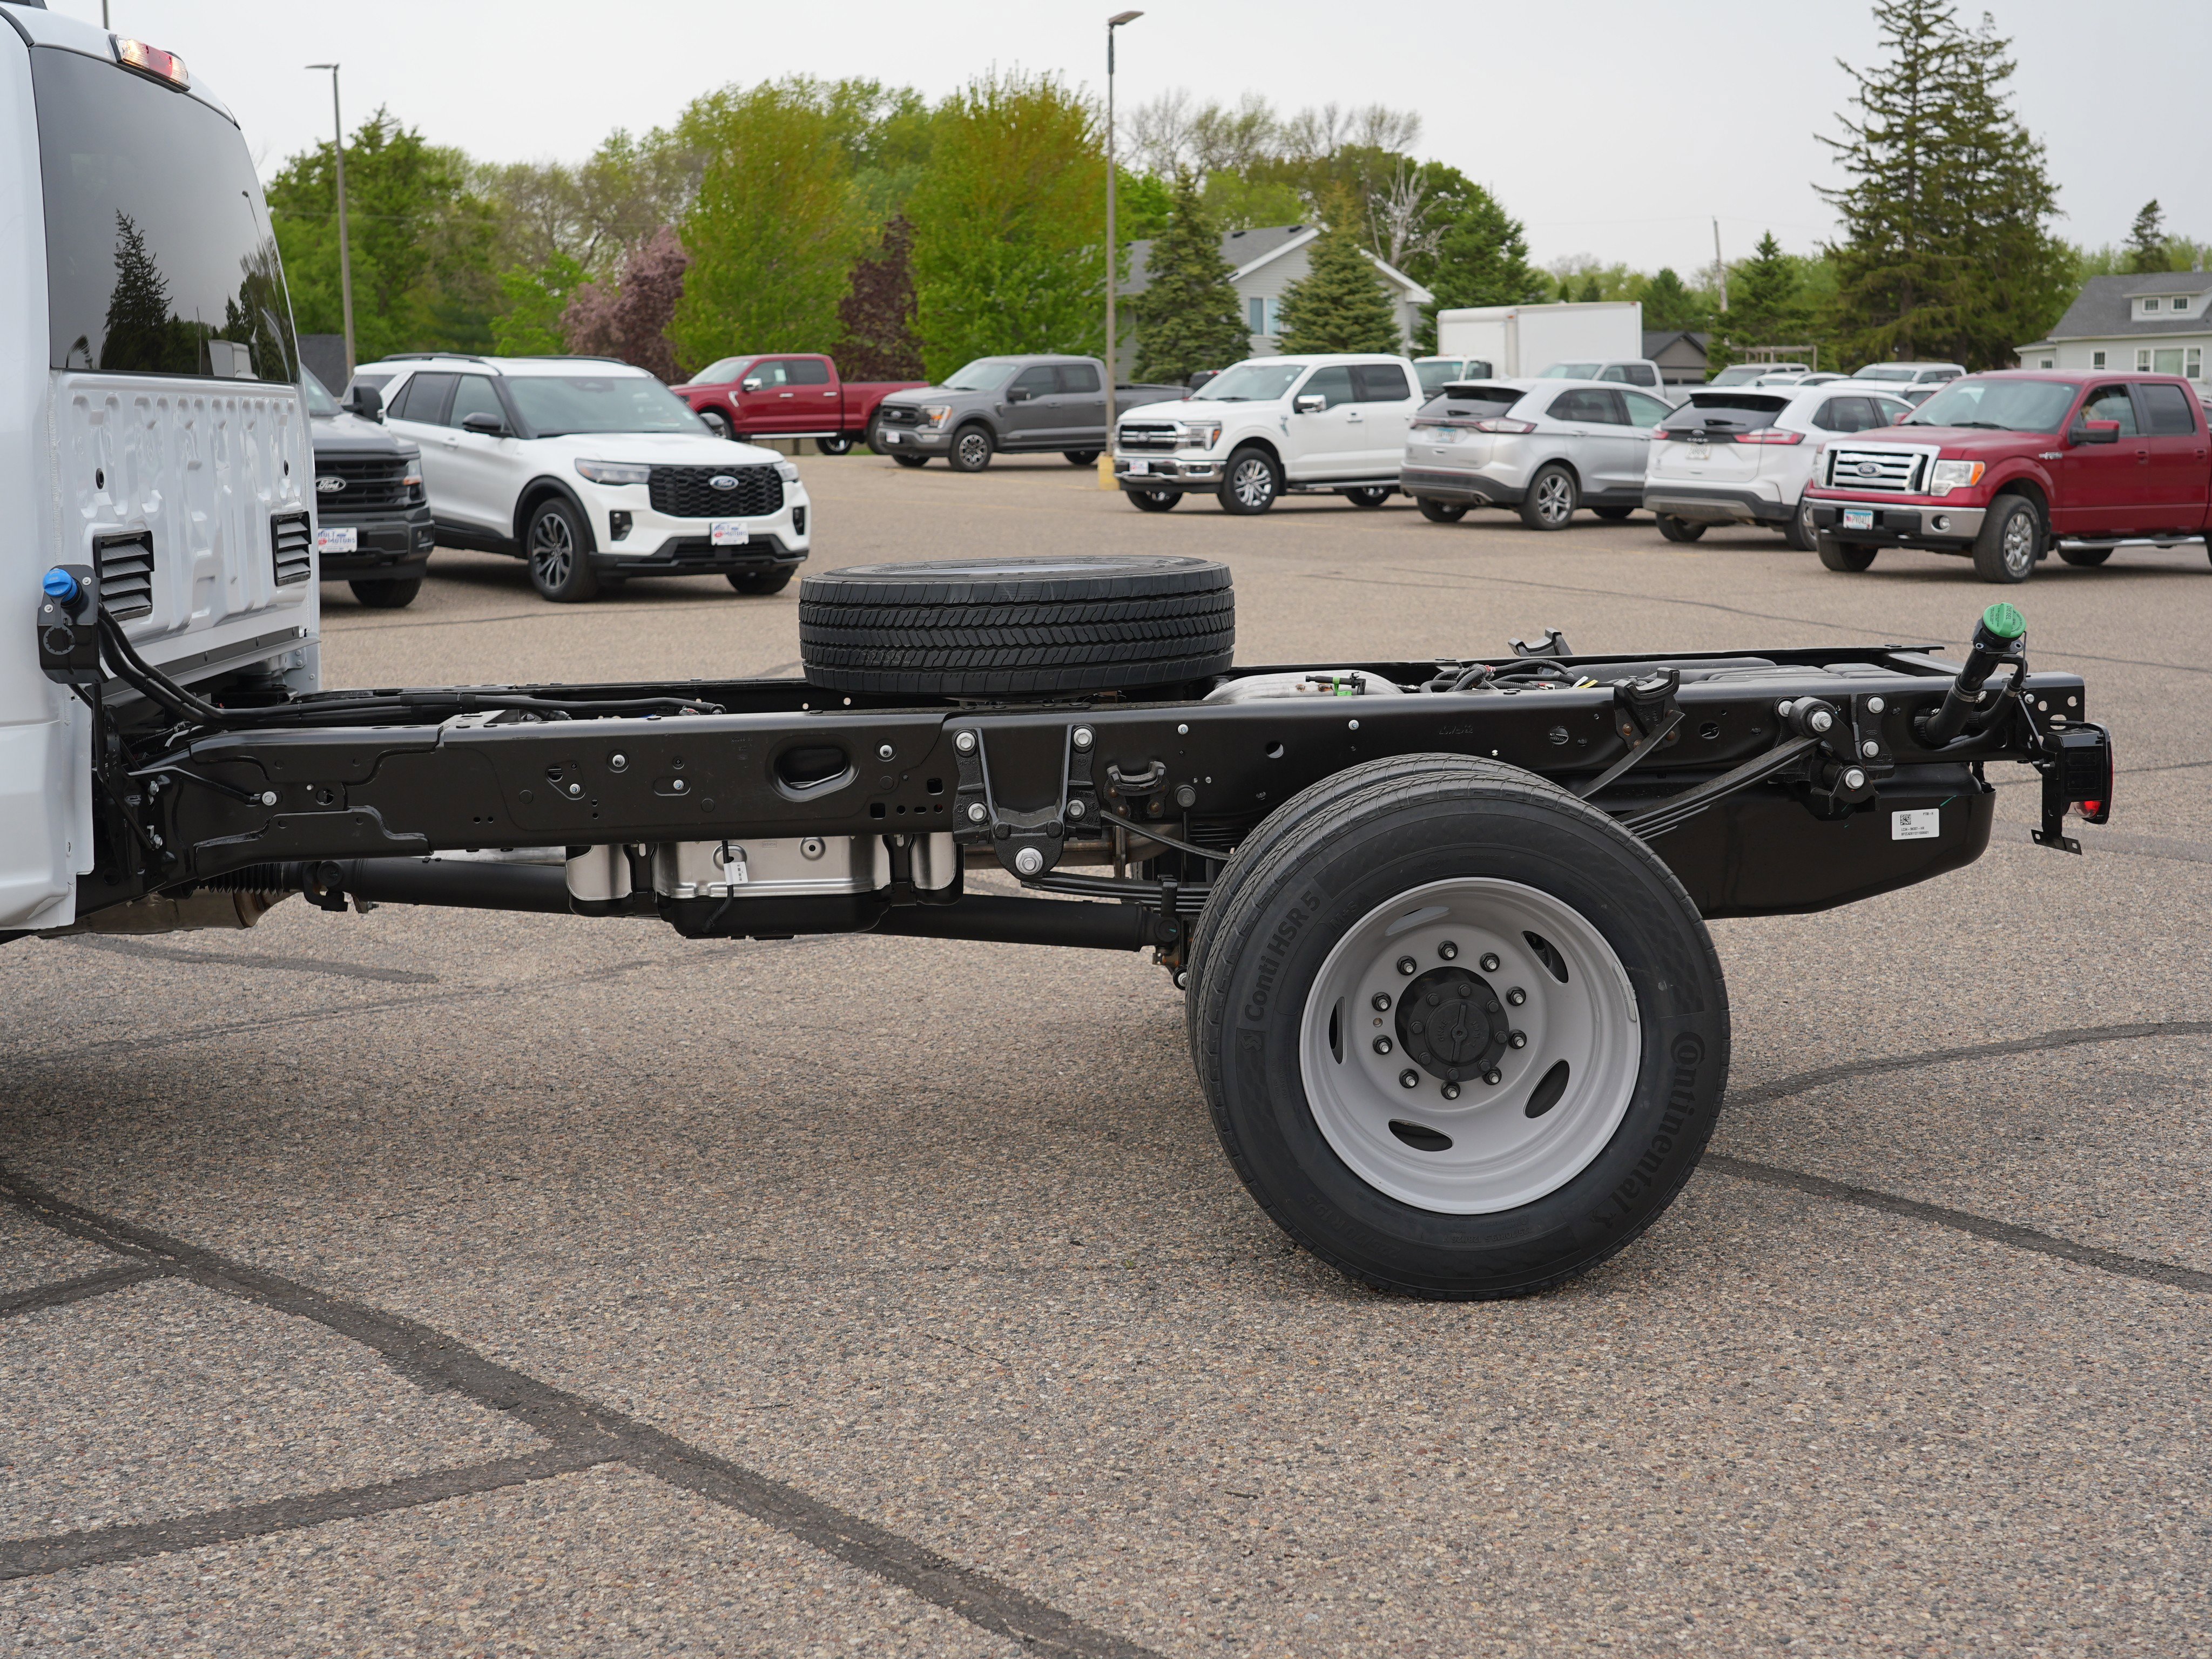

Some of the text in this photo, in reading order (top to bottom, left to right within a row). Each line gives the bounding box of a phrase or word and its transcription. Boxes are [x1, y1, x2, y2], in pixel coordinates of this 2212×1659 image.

[319, 479, 340, 490] Ford
[1245, 890, 1320, 1022] Conti HSR 5
[1611, 1031, 1705, 1214] Continental
